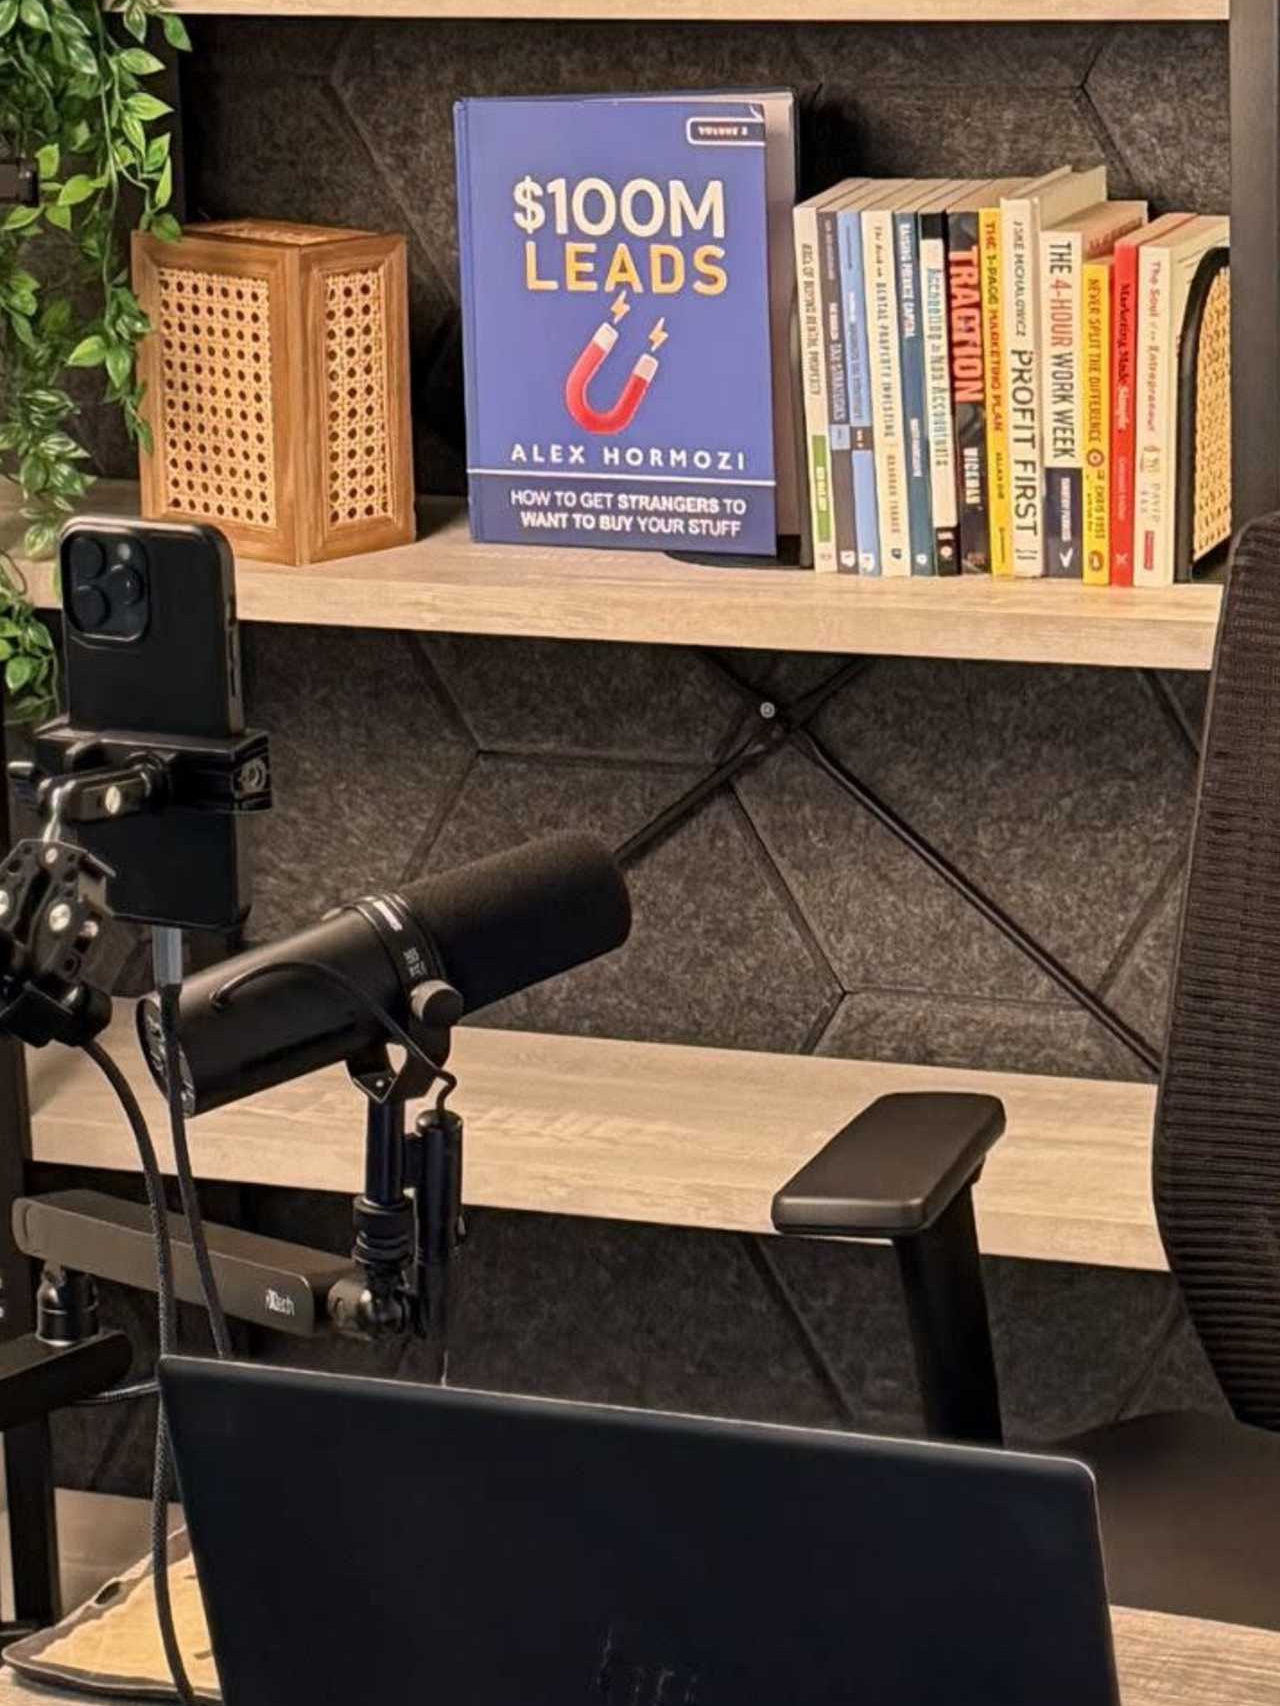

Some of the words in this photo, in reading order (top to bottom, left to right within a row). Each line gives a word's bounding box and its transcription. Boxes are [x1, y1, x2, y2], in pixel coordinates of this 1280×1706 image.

[512, 175, 725, 239] $100M
[985, 221, 997, 249] THE
[1049, 242, 1072, 274] THE
[525, 240, 728, 295] LEADS
[987, 254, 999, 305] 1-PAGE
[1151, 261, 1161, 284] The
[1050, 279, 1074, 347] 4-HOUR
[1088, 279, 1101, 315] NEVER
[1118, 283, 1130, 348] Marketing
[1150, 289, 1160, 317] Soul
[949, 245, 984, 402] TRACTION
[1089, 319, 1101, 349] SPLIT
[989, 310, 1002, 390] MARKETING
[1089, 352, 1101, 373] THE
[1011, 349, 1035, 449] PROFIT
[1051, 352, 1074, 404] WORK
[991, 394, 1003, 431] PLAN
[1053, 409, 1075, 458] WEEK
[1089, 376, 1101, 443] DIFFERENCE
[511, 444, 585, 464] ALEX
[603, 447, 745, 470] HORMOZI
[964, 447, 981, 504] WICKMAN
[510, 489, 551, 506] HOW
[554, 491, 577, 507] TO
[580, 492, 613, 508] GET
[617, 493, 719, 514] STRANGERS
[722, 498, 746, 515] TO
[1014, 459, 1038, 536] FIRST
[520, 511, 568, 529] WANT
[572, 513, 595, 530] TO
[598, 515, 633, 532] BUY
[636, 516, 684, 535] YOUR
[688, 519, 741, 537] STUFF
